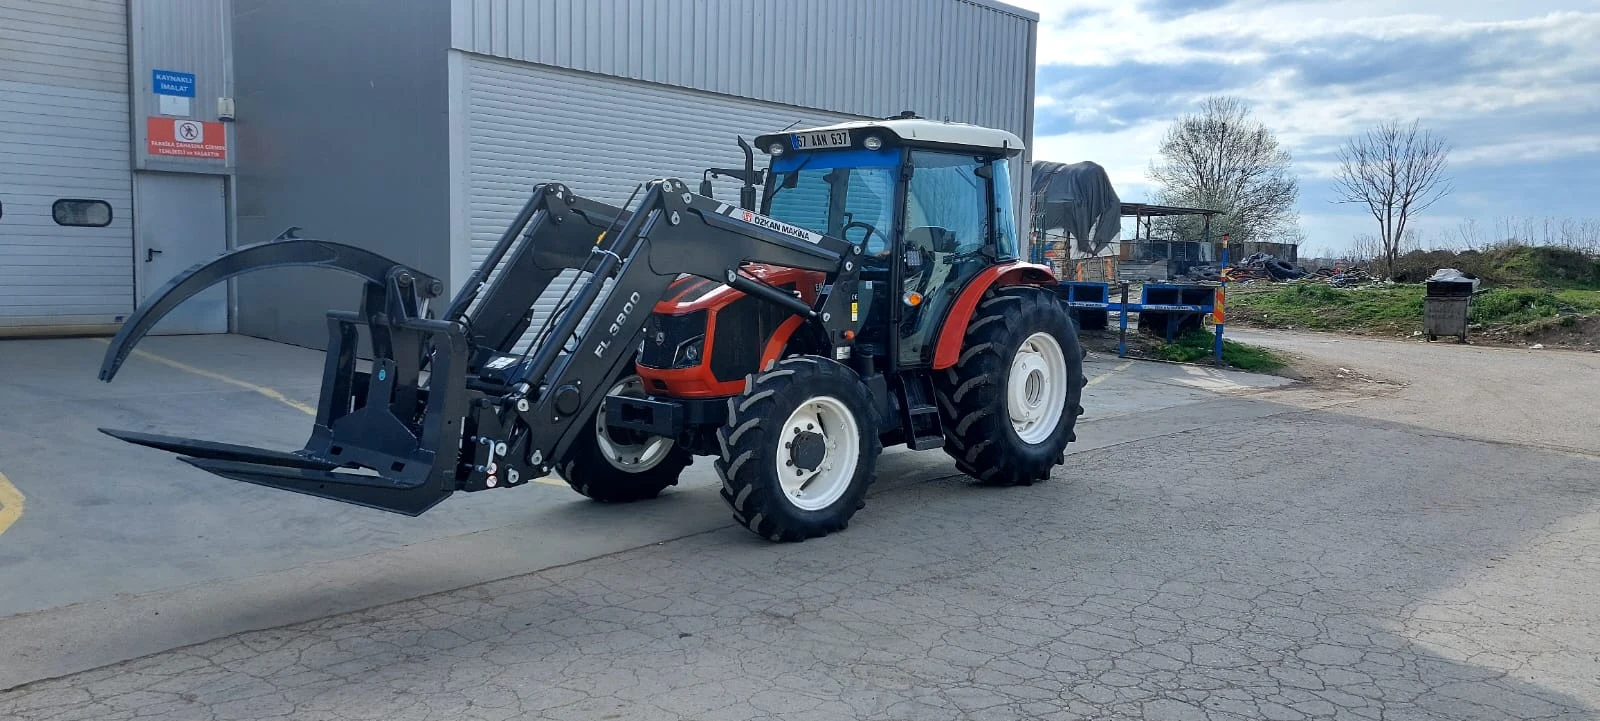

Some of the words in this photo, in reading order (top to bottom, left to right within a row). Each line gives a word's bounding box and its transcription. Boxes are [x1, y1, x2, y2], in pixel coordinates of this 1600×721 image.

[156, 74, 192, 84] KAYNAKLI
[811, 133, 828, 146] AAN
[830, 132, 847, 145] 637
[594, 340, 611, 358] FL
[609, 291, 640, 336] 3800
